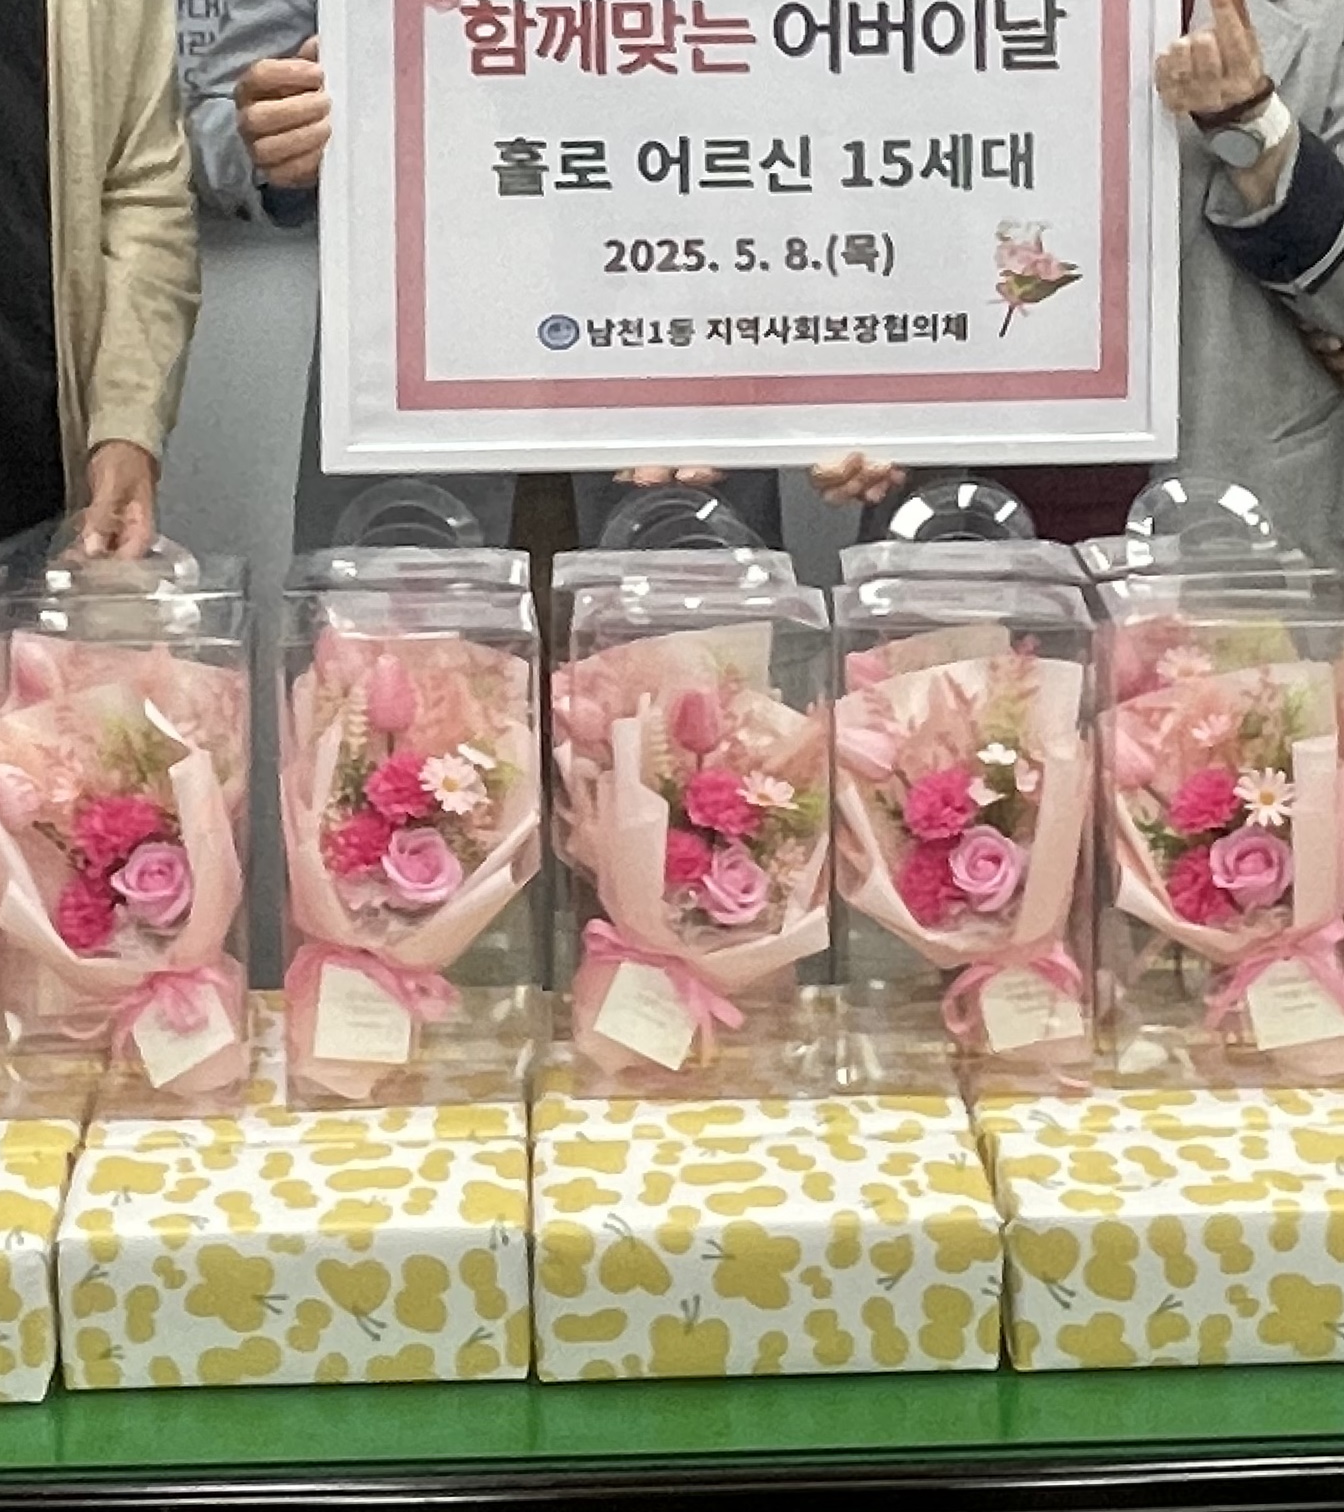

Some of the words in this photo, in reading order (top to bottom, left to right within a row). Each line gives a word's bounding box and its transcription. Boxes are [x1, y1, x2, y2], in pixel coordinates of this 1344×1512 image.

[490, 134, 614, 199] 홀로
[637, 131, 813, 193] 어르신
[840, 129, 1037, 192] 15세대
[602, 236, 719, 274] 2025.
[734, 236, 771, 273] 5.
[586, 316, 696, 348] 남천1동
[706, 312, 970, 346] 지역사회보장협의체
